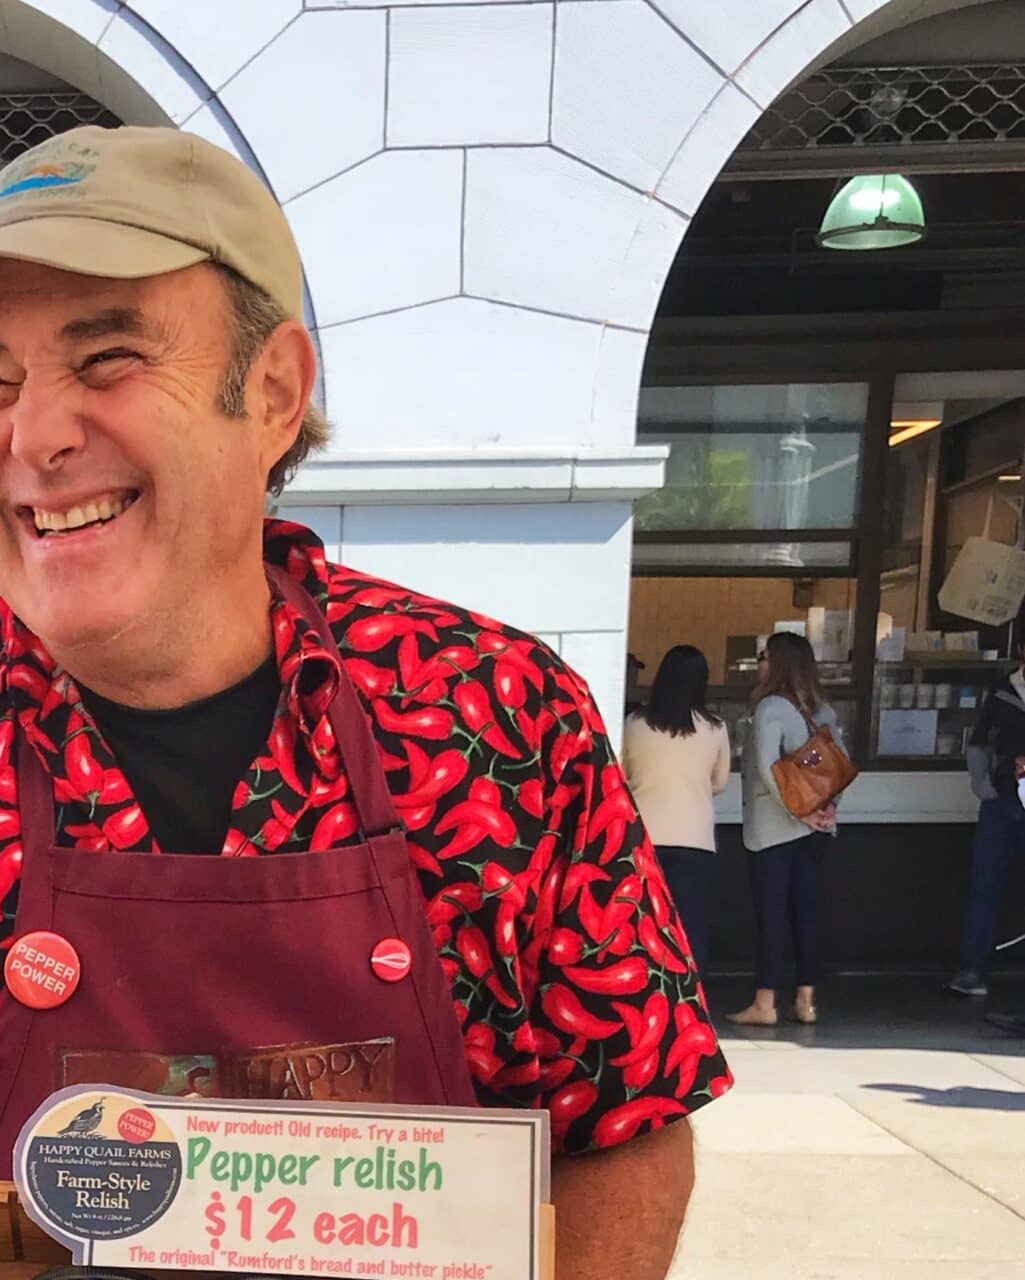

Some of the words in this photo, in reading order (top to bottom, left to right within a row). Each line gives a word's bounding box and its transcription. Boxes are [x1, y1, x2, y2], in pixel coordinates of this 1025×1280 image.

[10, 960, 66, 996] POWER
[16, 943, 75, 982] PEPPER
[186, 1116, 219, 1133] New
[225, 1120, 283, 1138] product!
[288, 1121, 311, 1138] Old
[316, 1123, 362, 1142] recipe.
[368, 1125, 394, 1144] Try
[398, 1129, 407, 1141] a
[413, 1127, 444, 1144] bite!
[39, 1144, 81, 1157] HAPPY
[84, 1146, 125, 1159] QUAIL
[128, 1148, 171, 1160] FARMS
[186, 1137, 320, 1193] Pepper
[333, 1146, 443, 1192] relish
[56, 1170, 151, 1194] Farm-Style
[76, 1191, 130, 1209] Relish
[204, 1191, 297, 1250] $12
[313, 1202, 418, 1249] each
[129, 1246, 155, 1263] The
[160, 1249, 215, 1267] original
[310, 1254, 352, 1273] bread
[357, 1257, 385, 1275] and
[390, 1259, 435, 1277] butter
